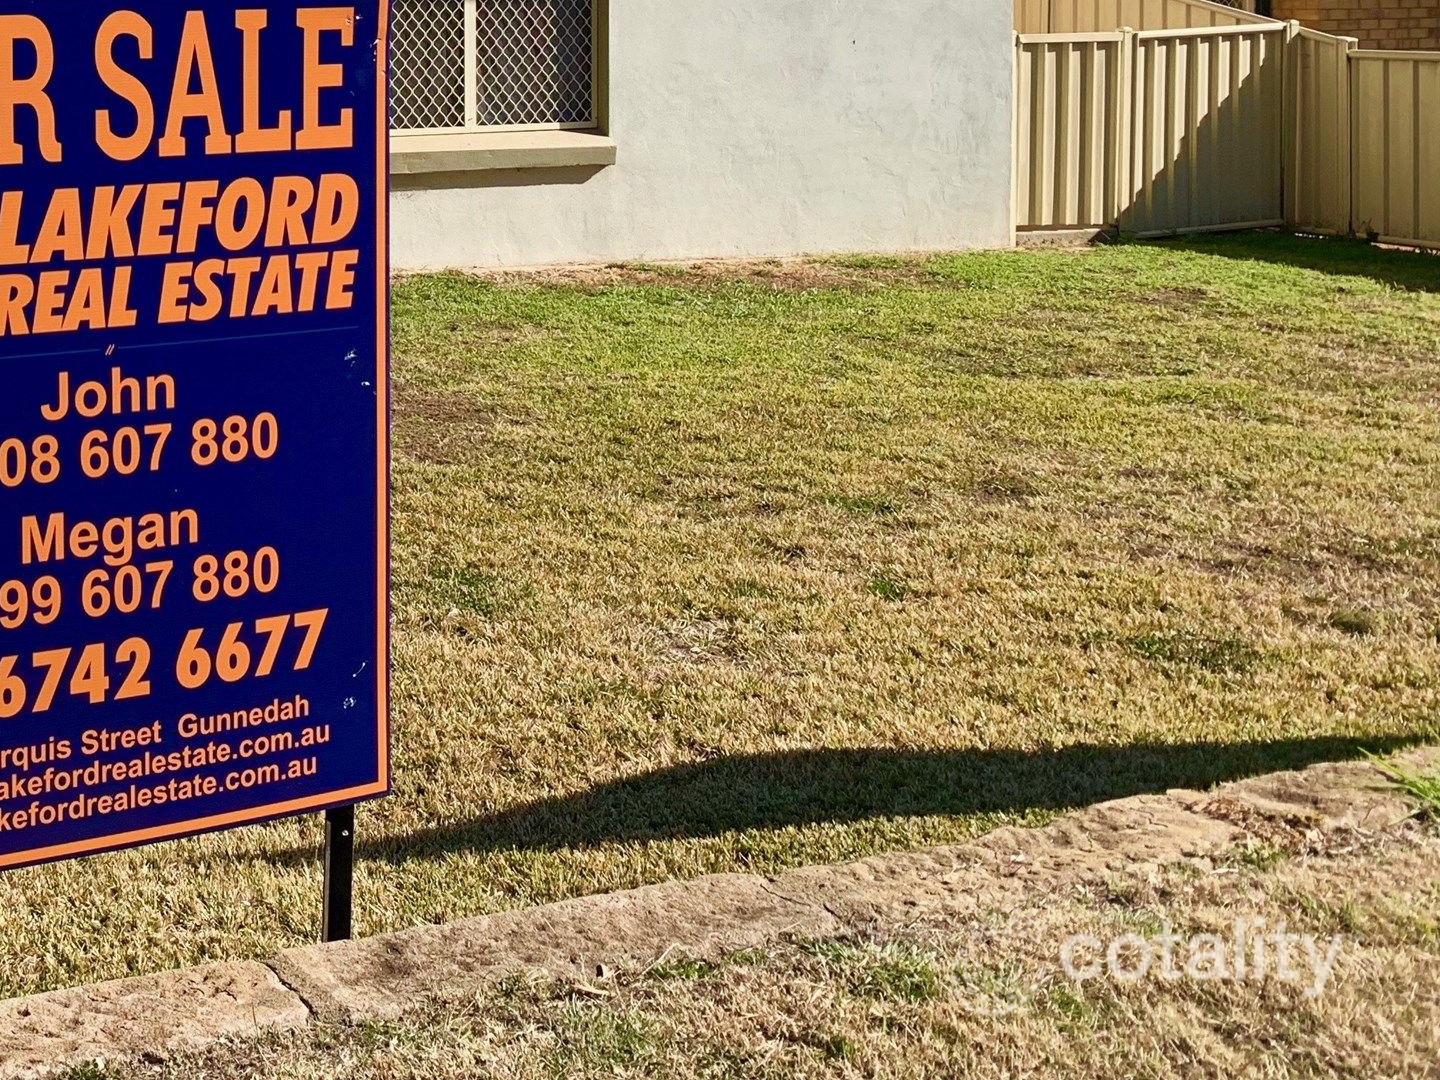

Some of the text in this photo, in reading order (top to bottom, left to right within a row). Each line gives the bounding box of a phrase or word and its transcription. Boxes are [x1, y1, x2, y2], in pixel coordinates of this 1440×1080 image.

[95, 7, 354, 160] SALE
[158, 250, 358, 323] ESTATE
[41, 368, 174, 420] John
[81, 423, 171, 477] 607
[192, 412, 277, 465] 880
[22, 509, 197, 566] Megan
[82, 561, 173, 617] 607
[193, 547, 279, 601] 880
[176, 609, 328, 688] 6677
[82, 722, 161, 754] Street
[178, 696, 308, 737] Gunnedah
